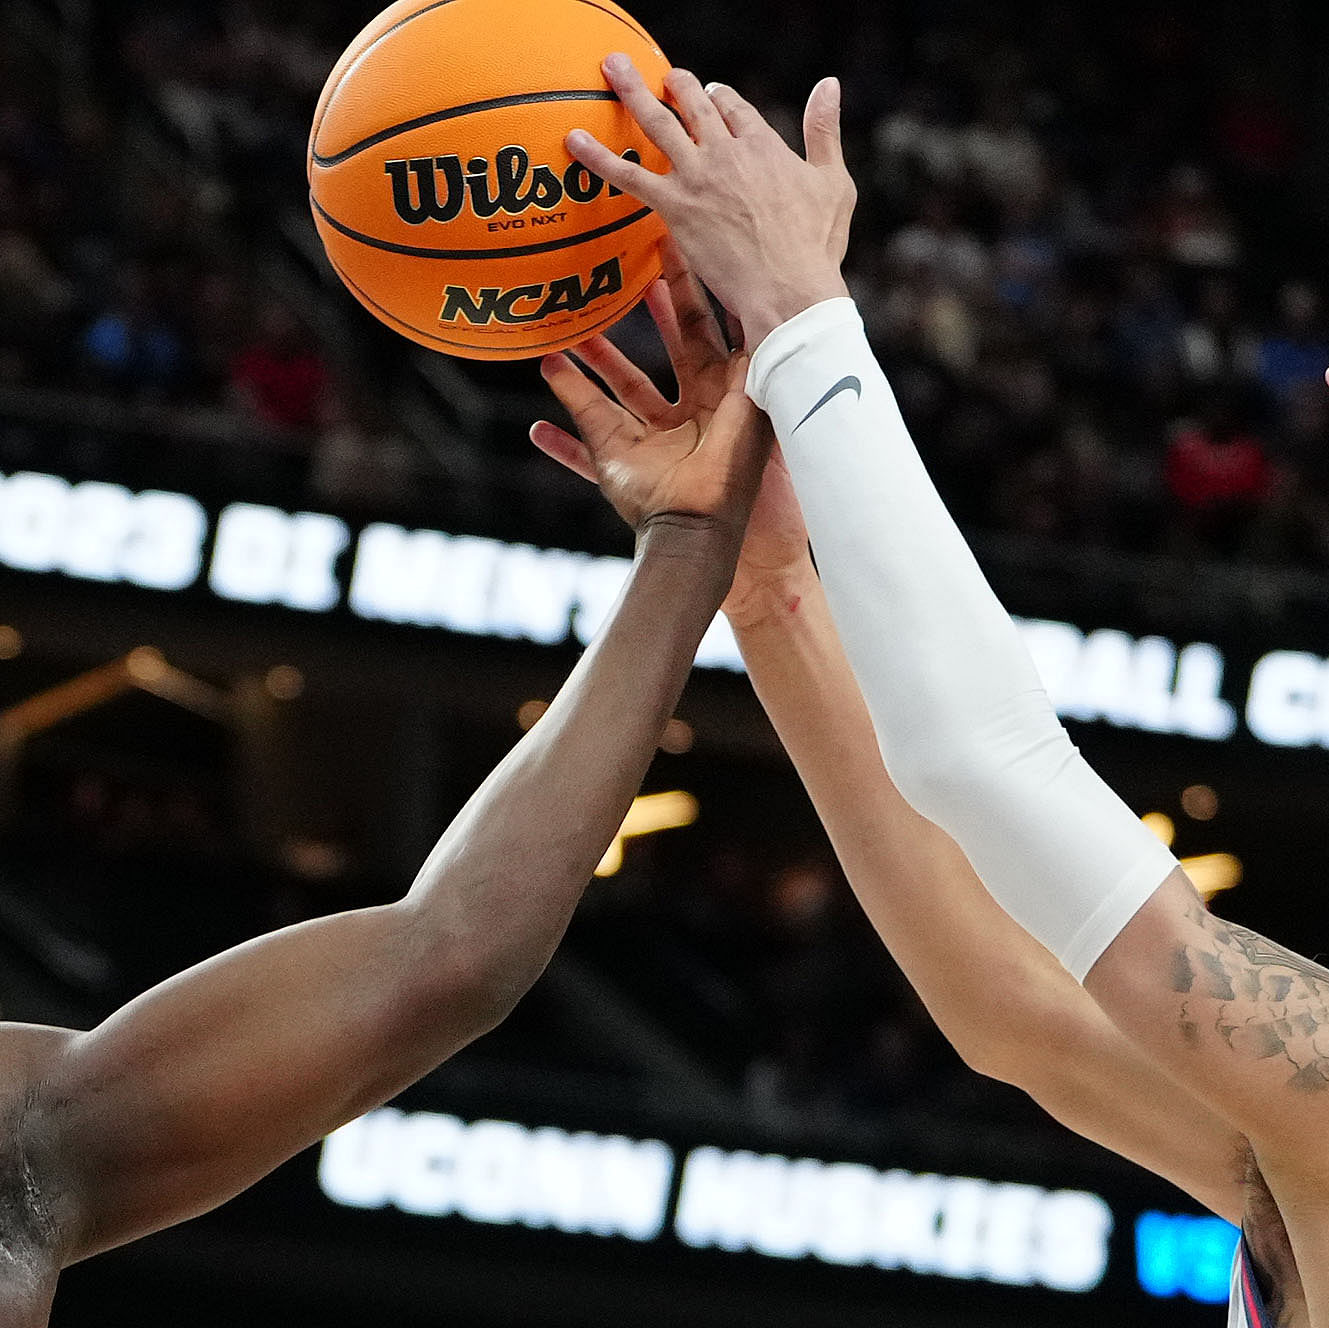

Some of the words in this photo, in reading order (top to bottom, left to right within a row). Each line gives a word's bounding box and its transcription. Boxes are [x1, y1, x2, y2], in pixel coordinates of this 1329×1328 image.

[488, 219, 525, 232] EVO
[531, 212, 568, 226] NXT
[438, 256, 623, 325] NCAA
[318, 1106, 672, 1241] UCONN
[676, 1146, 1112, 1292] HUSKIES
